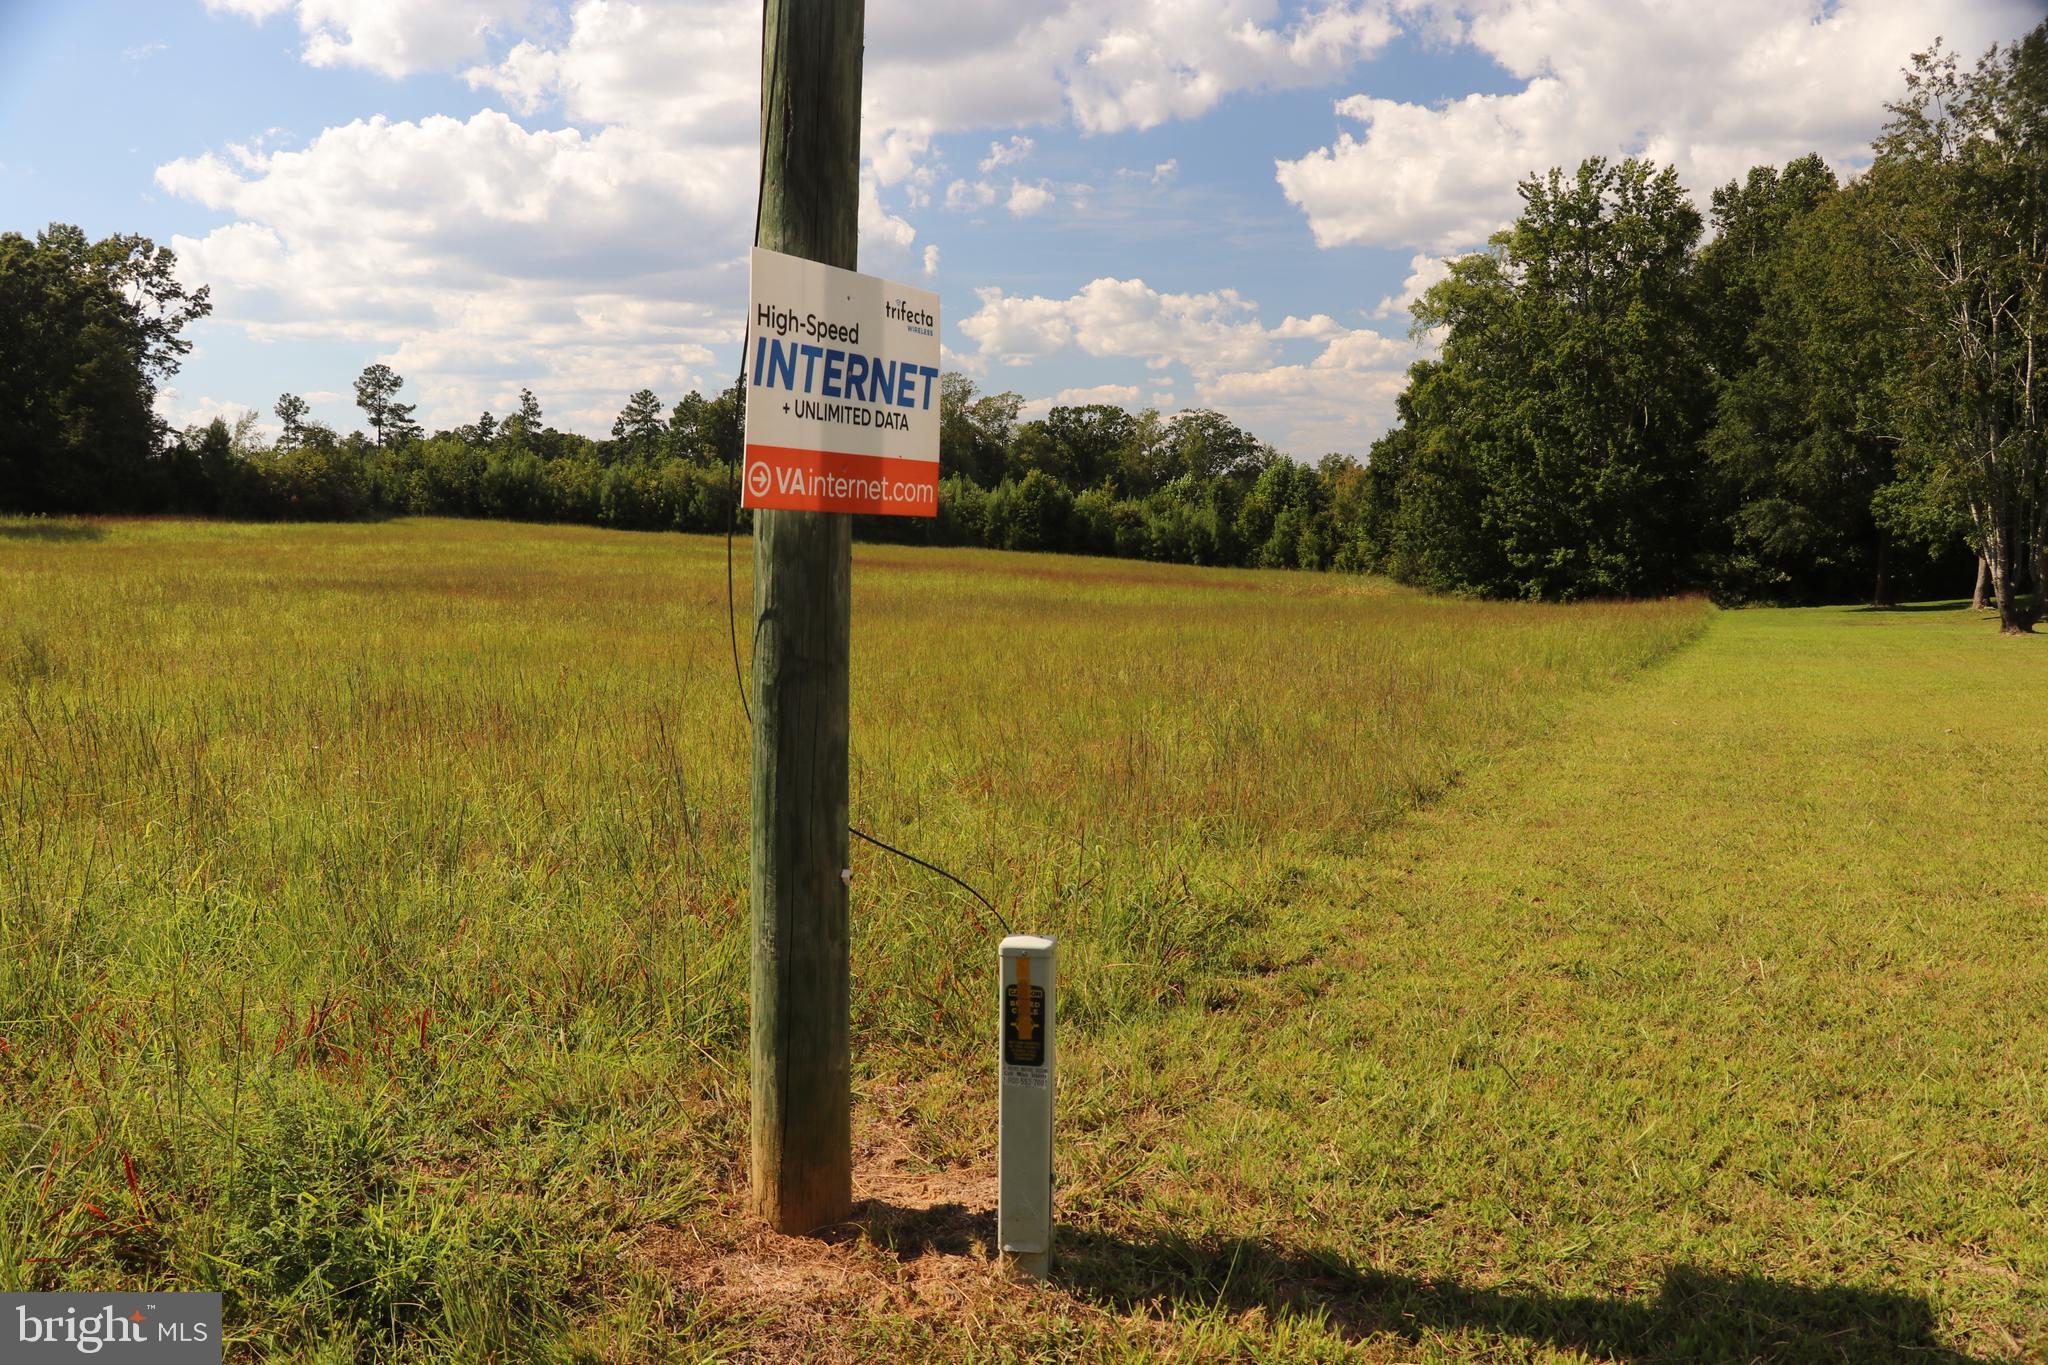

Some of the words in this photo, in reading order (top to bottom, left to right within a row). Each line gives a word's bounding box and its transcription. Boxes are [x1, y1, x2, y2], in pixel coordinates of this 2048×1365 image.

[757, 303, 859, 345] High-Speed
[886, 299, 933, 328] trifecta
[907, 325, 934, 337] WIRELESS
[753, 336, 939, 410] INTERNET
[782, 402, 790, 415] +
[794, 399, 872, 426] UNLIMITED
[875, 410, 910, 431] DATA
